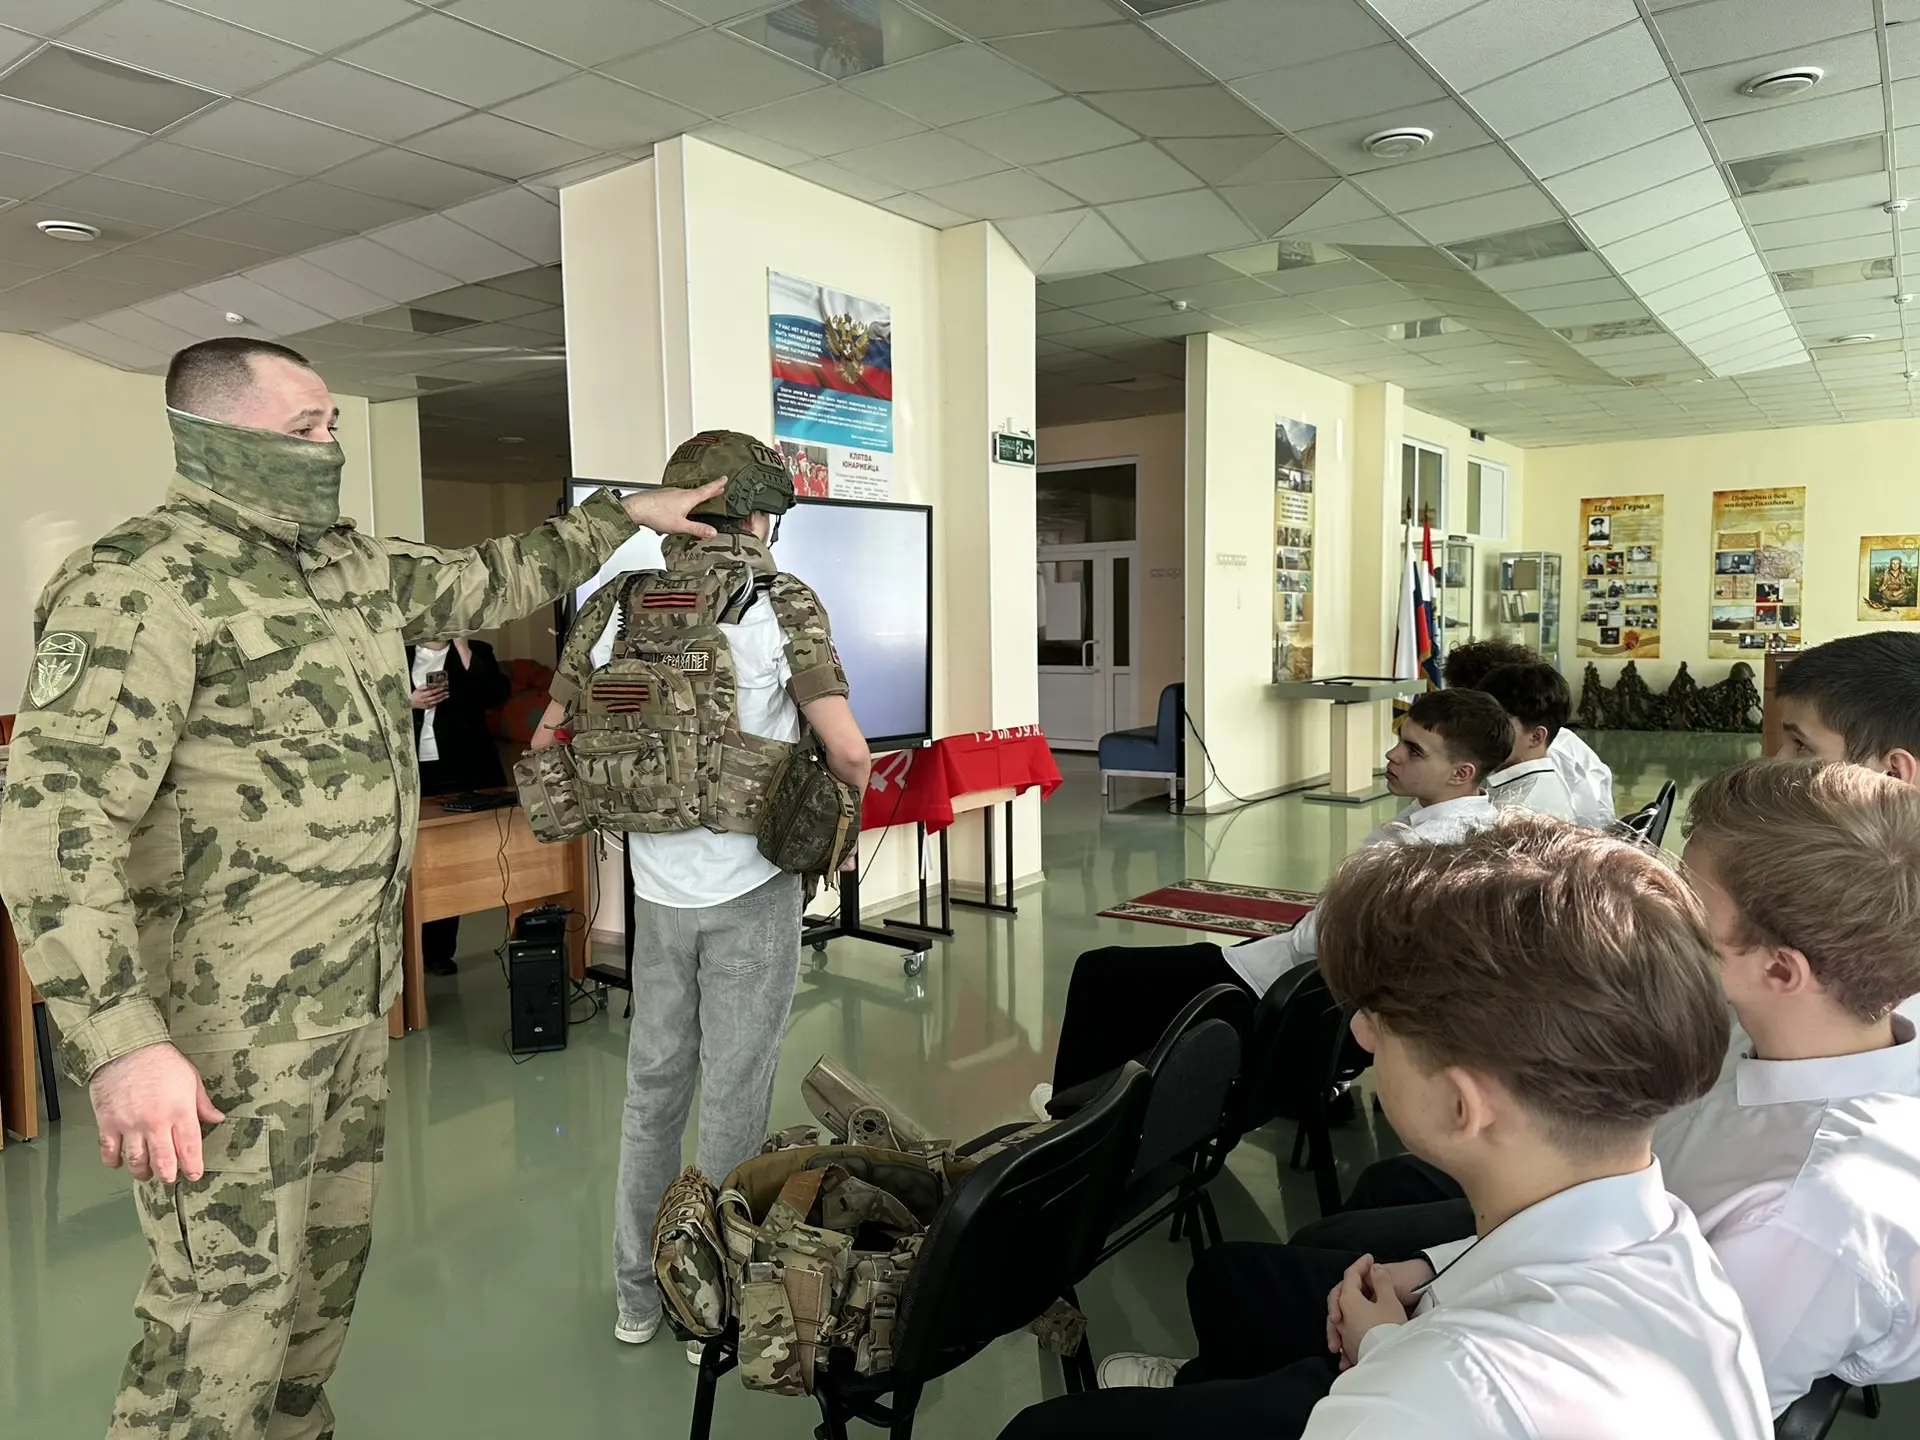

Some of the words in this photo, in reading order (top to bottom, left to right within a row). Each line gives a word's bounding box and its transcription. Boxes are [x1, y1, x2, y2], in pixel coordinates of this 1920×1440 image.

[754, 446, 782, 466] 715
[849, 452, 873, 462] КЛЯТВА
[842, 461, 880, 473] ЮНАРМЕЙЦА
[1594, 504, 1621, 513] Путь
[1623, 503, 1650, 511] Героя
